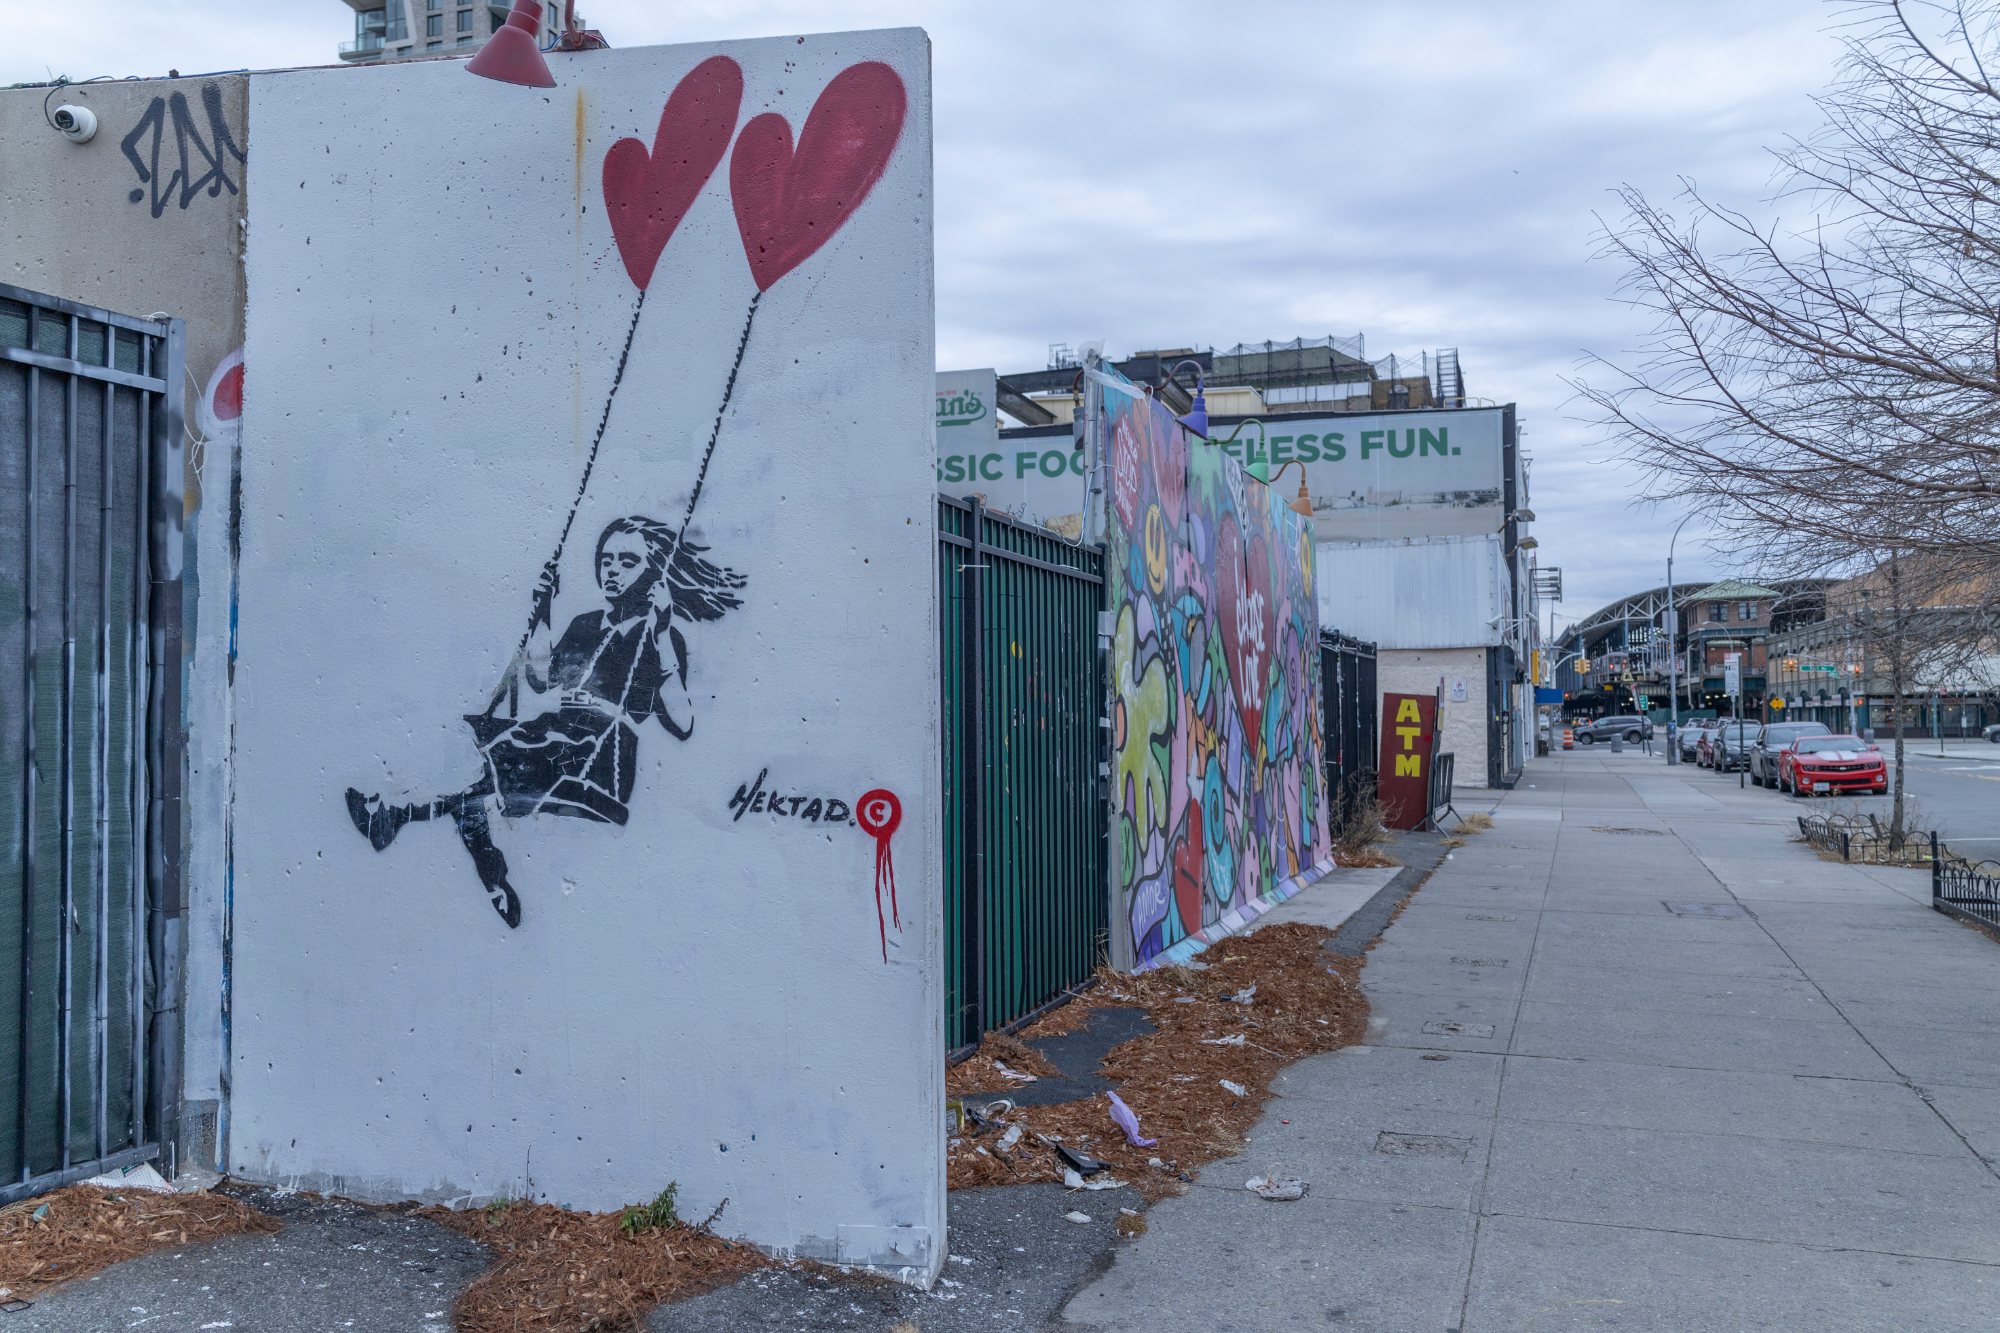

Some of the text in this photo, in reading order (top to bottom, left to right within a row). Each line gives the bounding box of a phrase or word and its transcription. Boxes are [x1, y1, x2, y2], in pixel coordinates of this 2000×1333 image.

[1360, 427, 1461, 460] FUN.
[1238, 647, 1262, 711] LOVE
[1395, 698, 1421, 778] ATM
